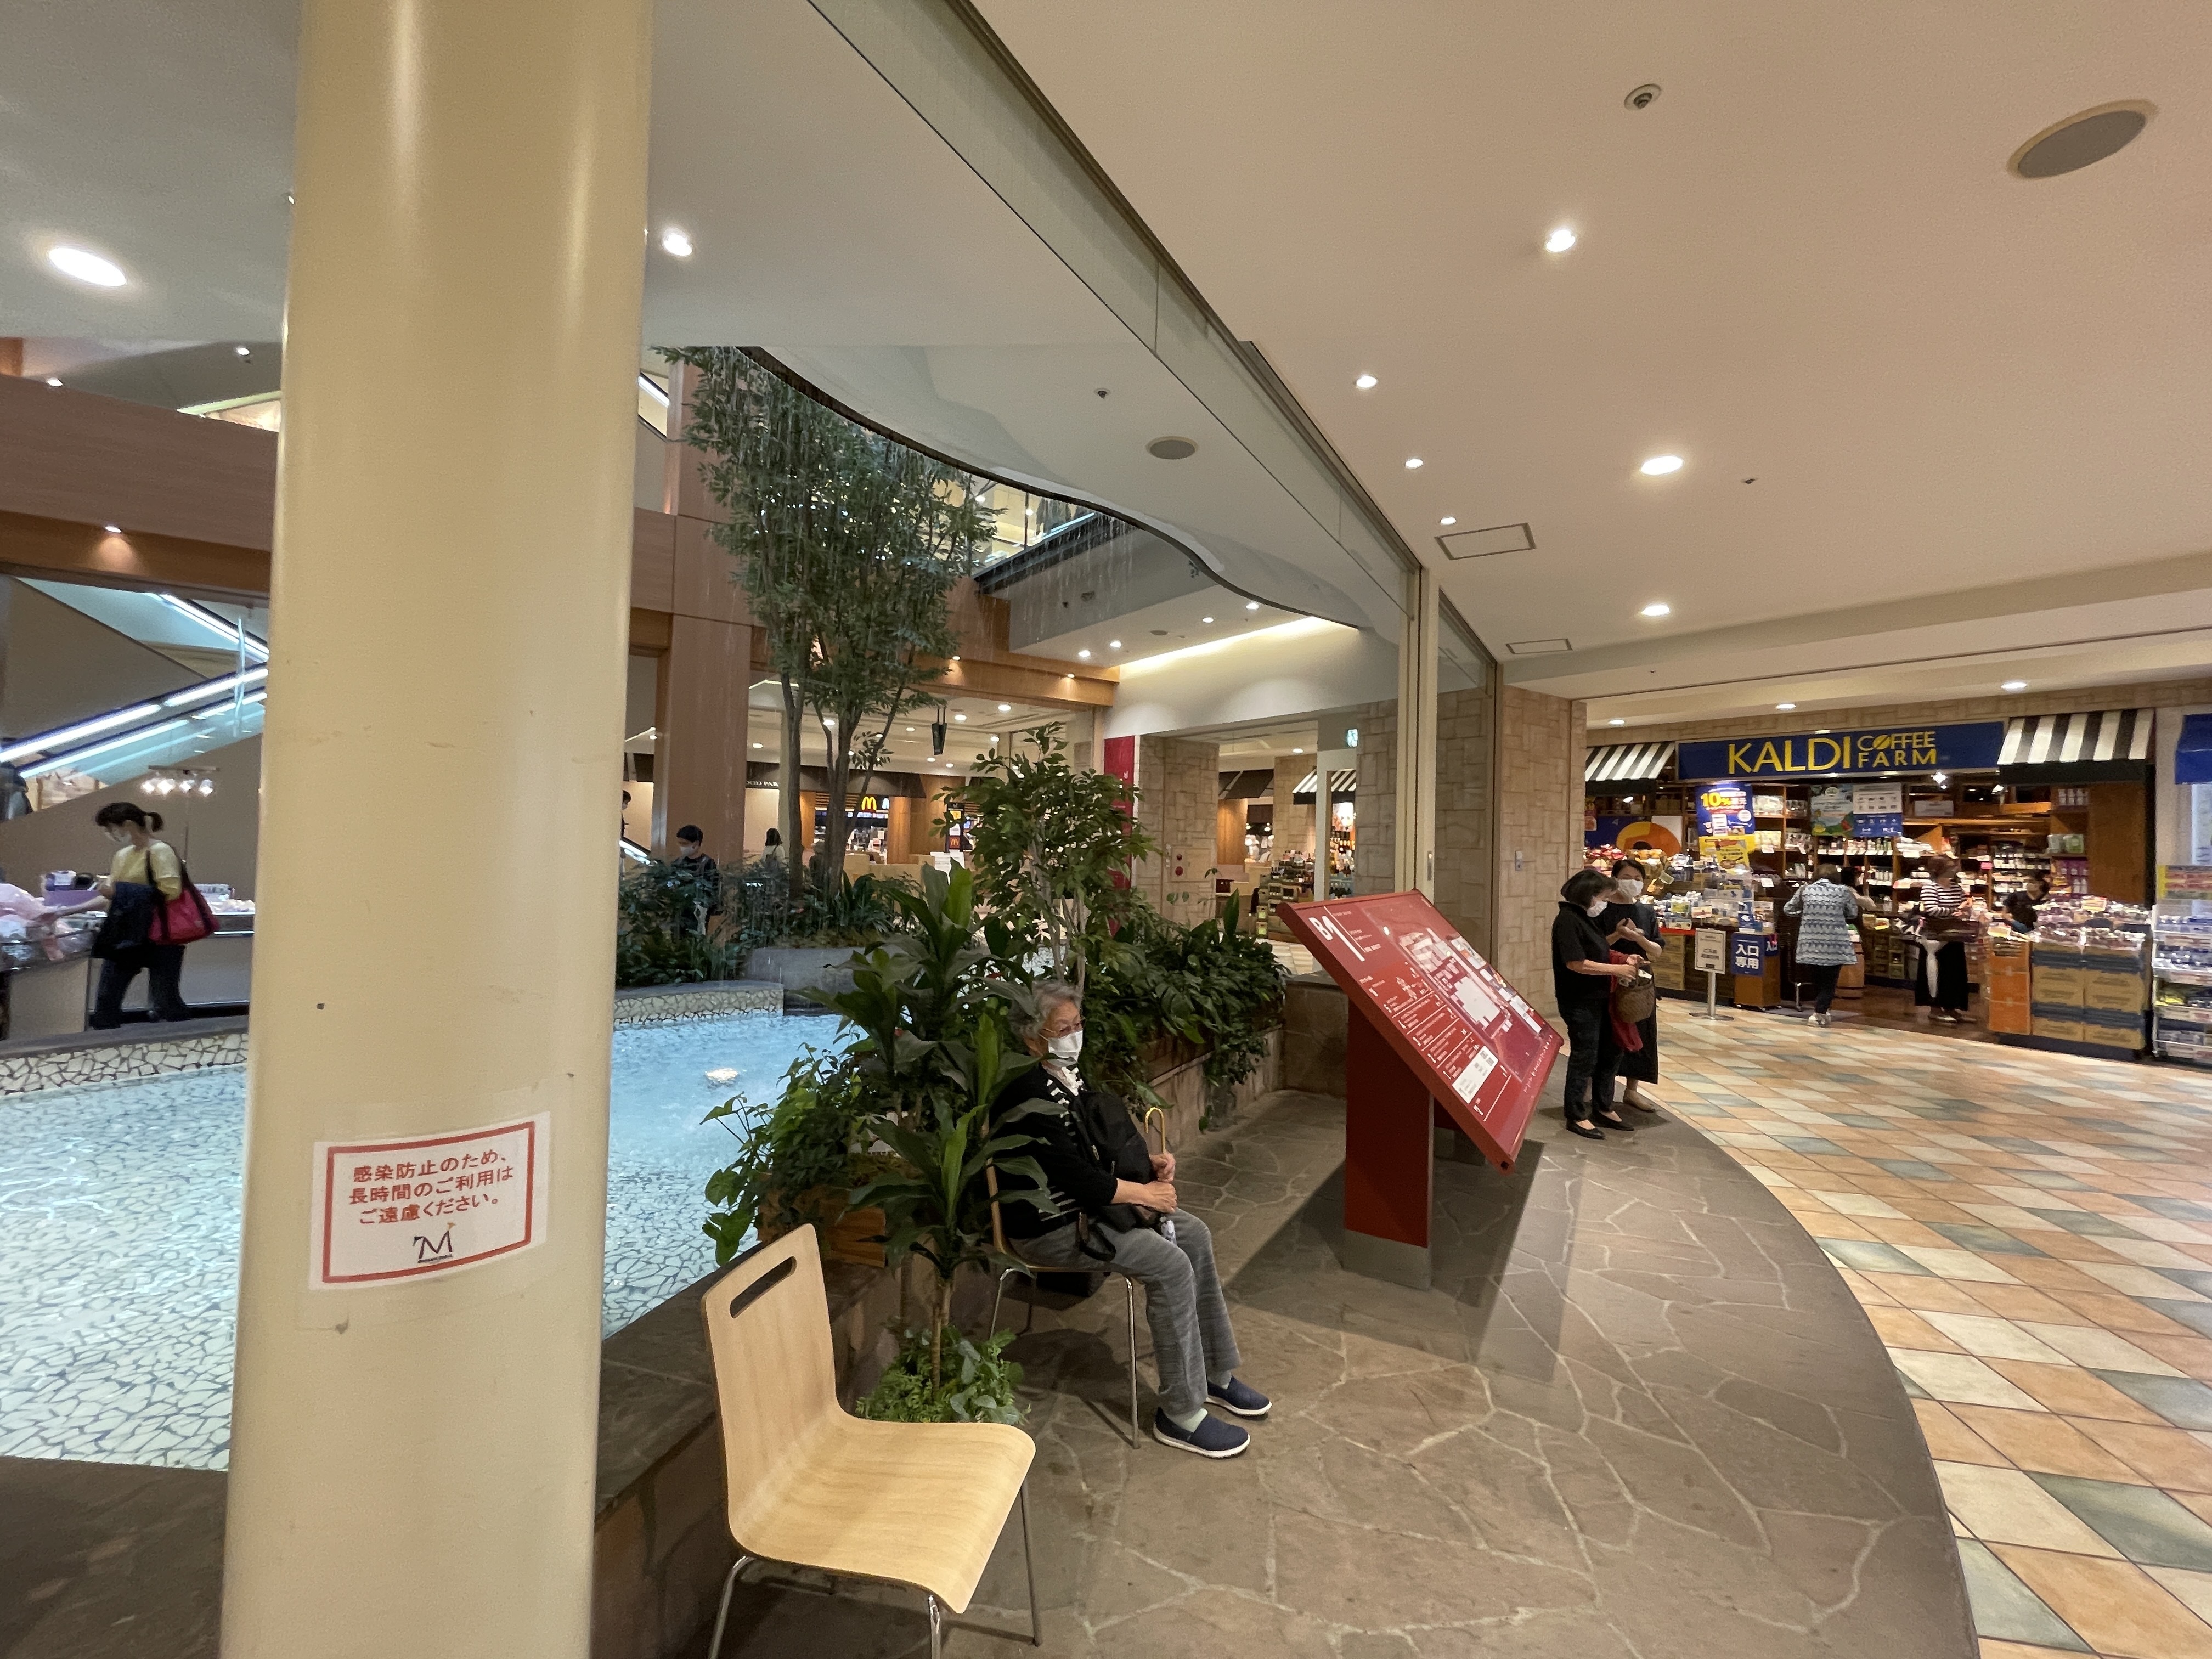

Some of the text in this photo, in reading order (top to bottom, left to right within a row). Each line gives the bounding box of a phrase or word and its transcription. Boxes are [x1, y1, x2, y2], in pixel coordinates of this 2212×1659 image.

[1729, 736, 1850, 774] KALDI
[1857, 731, 1936, 751] COFFEE
[1858, 748, 1937, 768] FARM
[1308, 916, 1365, 962] B1
[1735, 944, 1759, 957] 入口
[1735, 956, 1759, 969] 専用
[353, 1149, 507, 1183] 感染防止のため、
[348, 1166, 514, 1205] 長時間のご利用は
[360, 1192, 498, 1224] ご遠慮ください。
